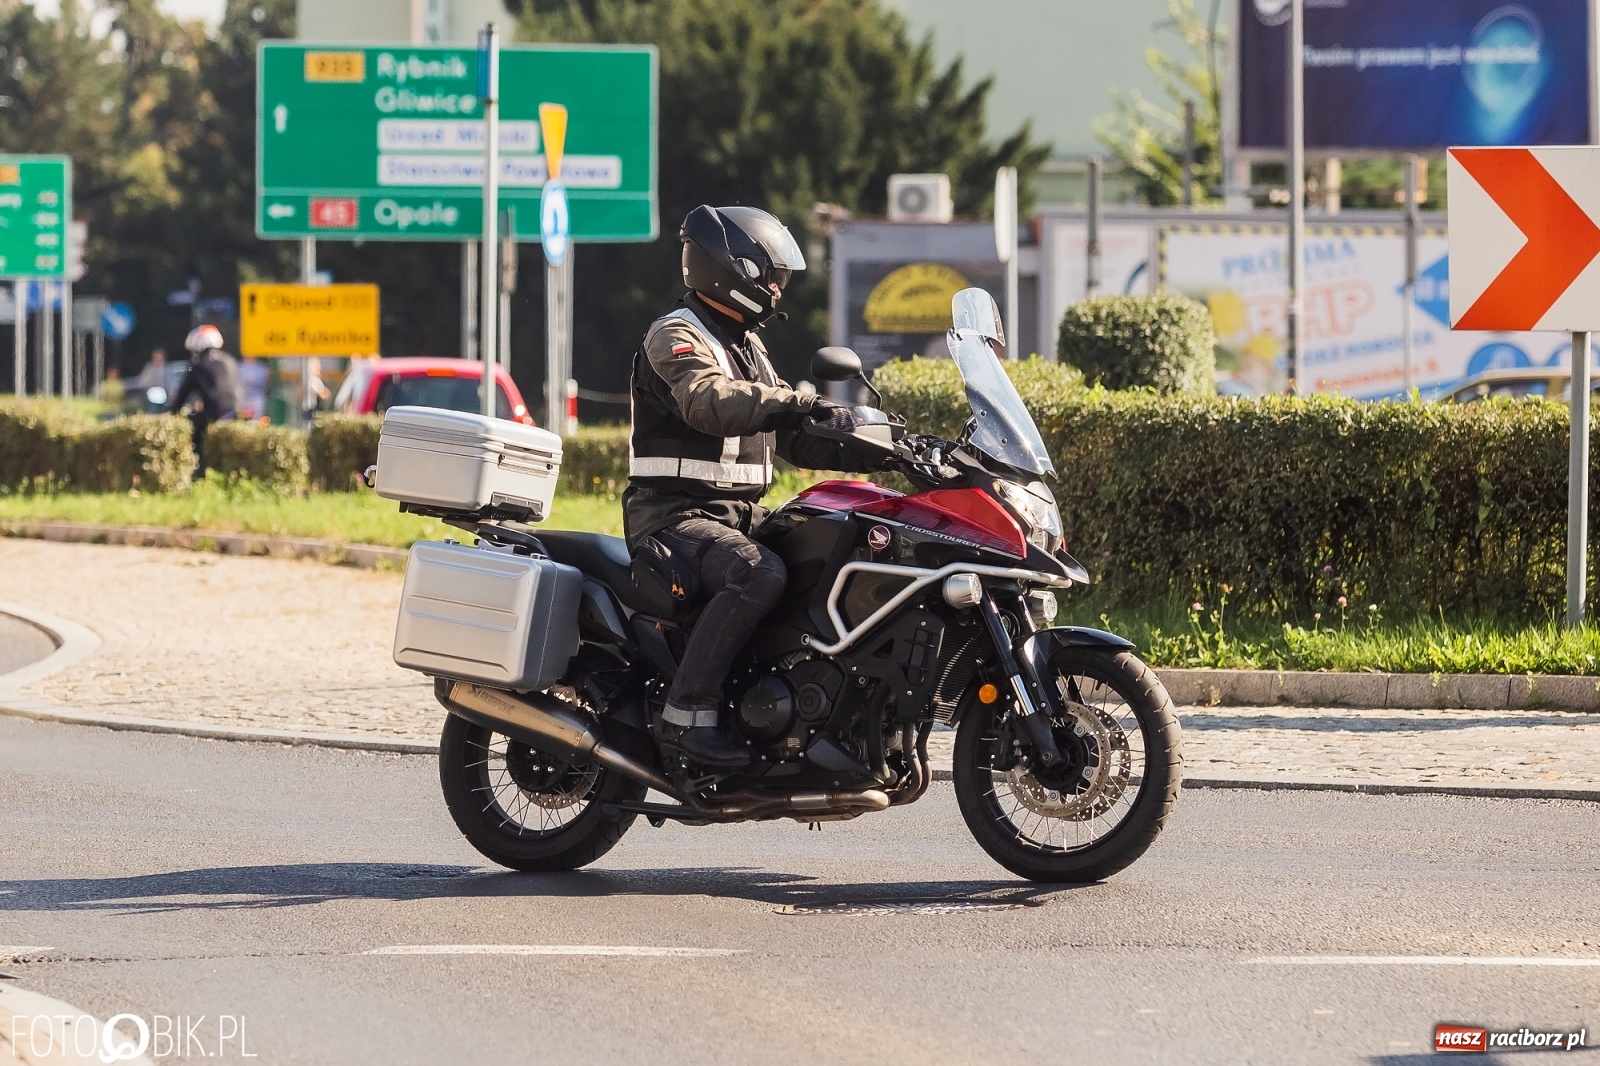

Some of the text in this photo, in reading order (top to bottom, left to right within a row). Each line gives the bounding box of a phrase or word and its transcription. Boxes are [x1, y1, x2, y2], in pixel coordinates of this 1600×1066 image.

[377, 53, 467, 83] Rybnik
[375, 86, 477, 114] Gliwice
[319, 200, 459, 227] 45 Opole
[1221, 238, 1357, 280] PROIMA
[1245, 279, 1376, 342] BHP
[264, 327, 374, 348] do Rybnika
[904, 524, 981, 549] CROSSTOURER
